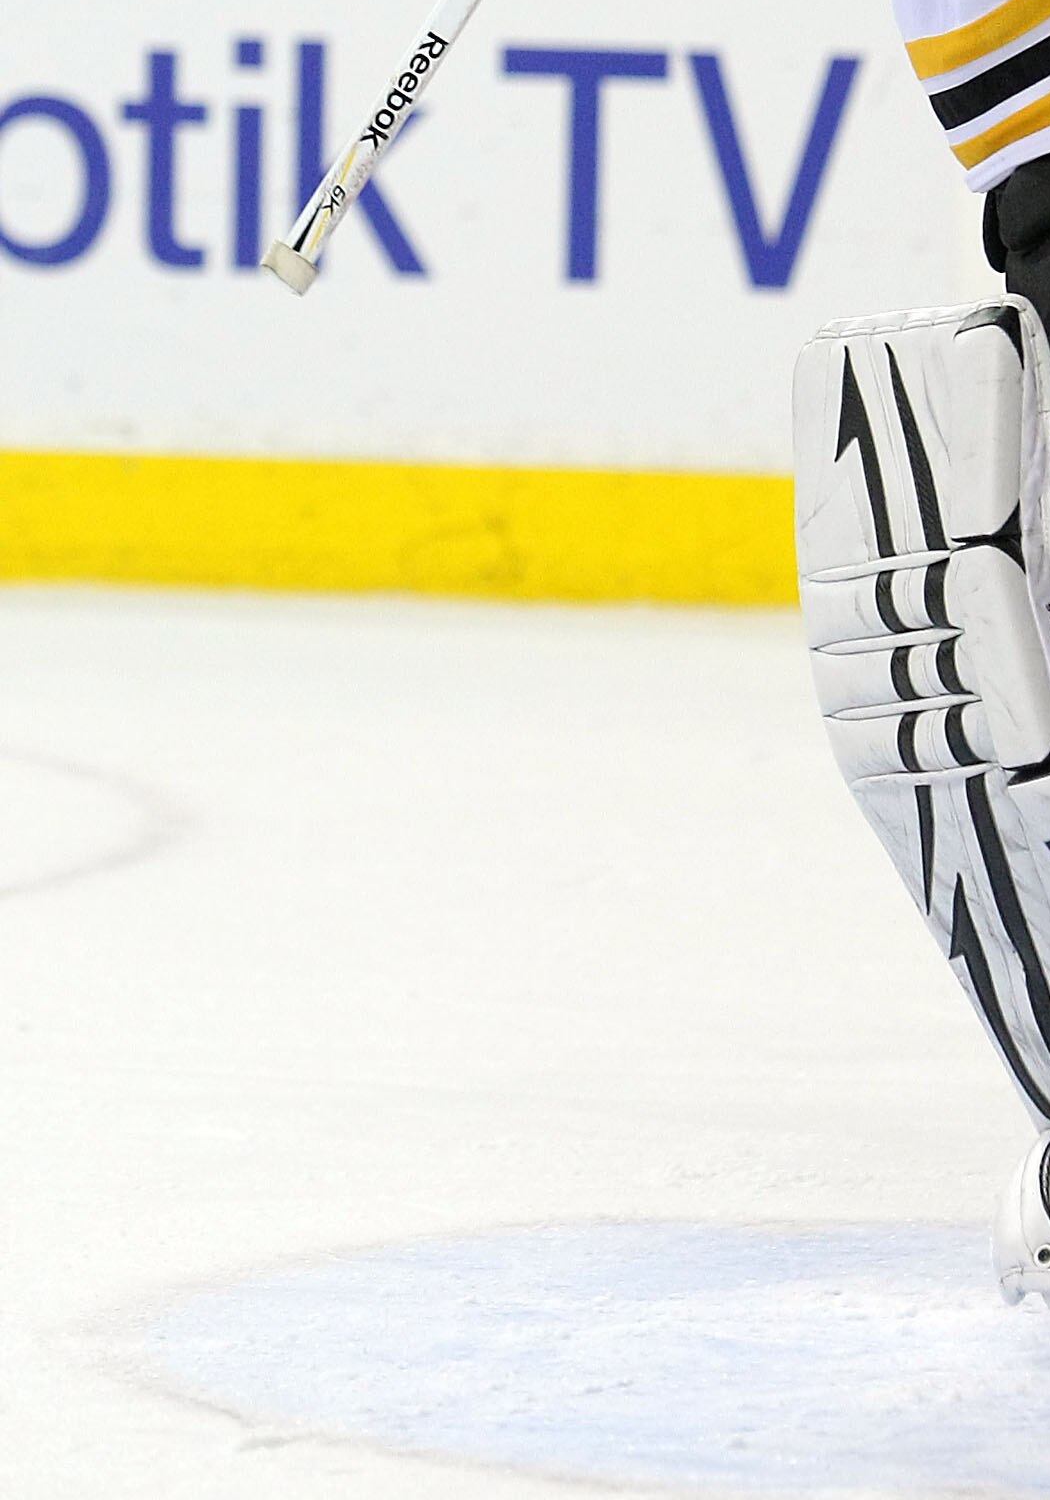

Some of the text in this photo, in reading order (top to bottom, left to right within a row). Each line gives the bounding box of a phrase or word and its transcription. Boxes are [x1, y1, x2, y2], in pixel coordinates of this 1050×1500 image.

[359, 30, 450, 151] Reebok
[321, 184, 346, 216] 6K
[502, 47, 861, 287] TV
